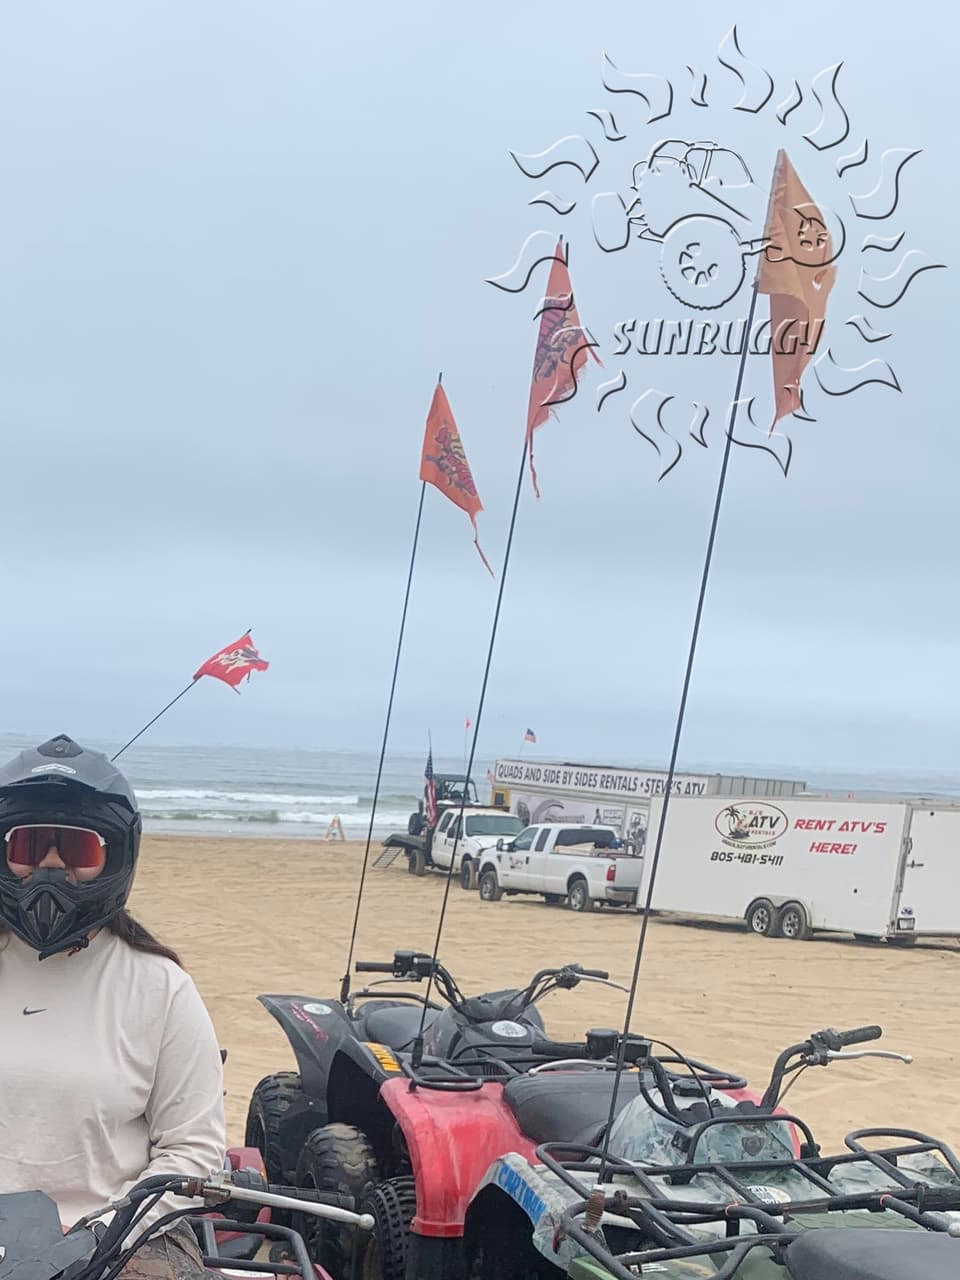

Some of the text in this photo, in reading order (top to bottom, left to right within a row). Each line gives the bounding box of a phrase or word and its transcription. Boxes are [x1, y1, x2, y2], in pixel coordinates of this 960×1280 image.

[498, 764, 706, 795] QUADS AND SIDE BY SIDES RENTALS STEV'S ATV
[748, 815, 781, 829] ATV
[794, 818, 888, 834] RENT ATV'S
[809, 841, 858, 855] HERE!
[710, 851, 785, 867] 805-481-5411
